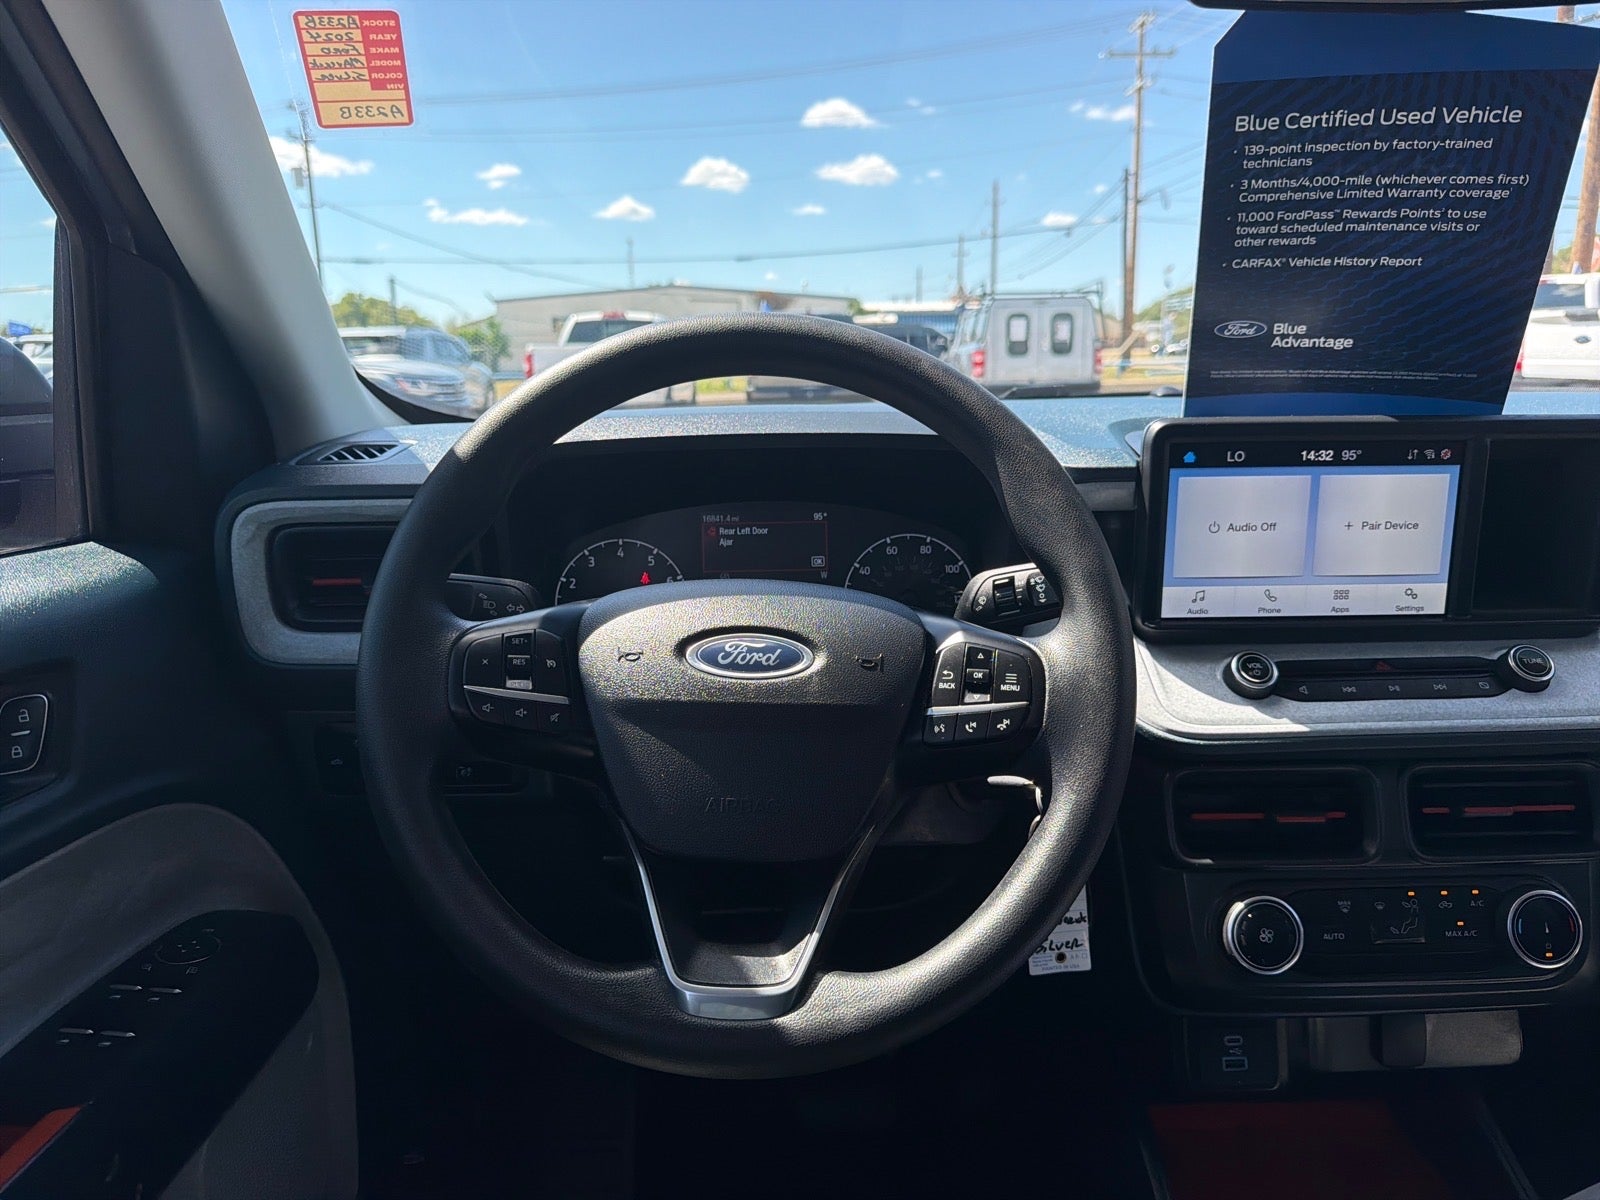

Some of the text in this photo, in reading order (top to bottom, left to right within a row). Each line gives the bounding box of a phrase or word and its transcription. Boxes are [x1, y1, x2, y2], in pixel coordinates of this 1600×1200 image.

[1234, 105, 1523, 132] Blue Certified Used Vehicle
[1244, 138, 1494, 156] 139-point inspection by factory-trained
[1243, 157, 1313, 169] technicians
[1240, 173, 1530, 190] 3 Months/4,000-mile (whichever comes first)
[1239, 189, 1334, 203] Comprehensive
[1336, 188, 1384, 199] Limited
[1387, 187, 1446, 200] Warranty
[1237, 211, 1274, 223] 11,000
[1342, 208, 1397, 220] Rewards
[1447, 209, 1461, 219] to
[1463, 210, 1487, 219] use
[1236, 221, 1480, 235] toward scheduled maintenance visits or
[1234, 235, 1317, 247] other rewards
[1288, 257, 1331, 268] Vehicle
[1333, 255, 1378, 268] History
[1380, 256, 1423, 268] Report
[1223, 323, 1258, 336] Ford
[1272, 323, 1307, 335] Blue
[1270, 336, 1354, 350] Advantage
[1227, 450, 1245, 462] LO
[1300, 450, 1334, 461] 14:32
[1227, 522, 1277, 532] Audio Off
[1361, 520, 1419, 530] Pair Device
[719, 527, 769, 535] Rear Left Door
[719, 538, 733, 547] Ajar
[616, 548, 625, 558] 4
[886, 545, 898, 555] 60
[919, 545, 932, 554] 80
[587, 556, 595, 567] 3
[648, 555, 655, 566] 5
[859, 566, 871, 576] 40
[944, 564, 960, 573] 100
[820, 571, 828, 579] W
[568, 578, 577, 589] 2
[1395, 605, 1424, 613] Settings
[717, 641, 782, 666] Ford
[512, 658, 526, 666] RES
[973, 671, 983, 679] OK
[1000, 684, 1021, 692] MENU
[1463, 929, 1478, 937] A/C
